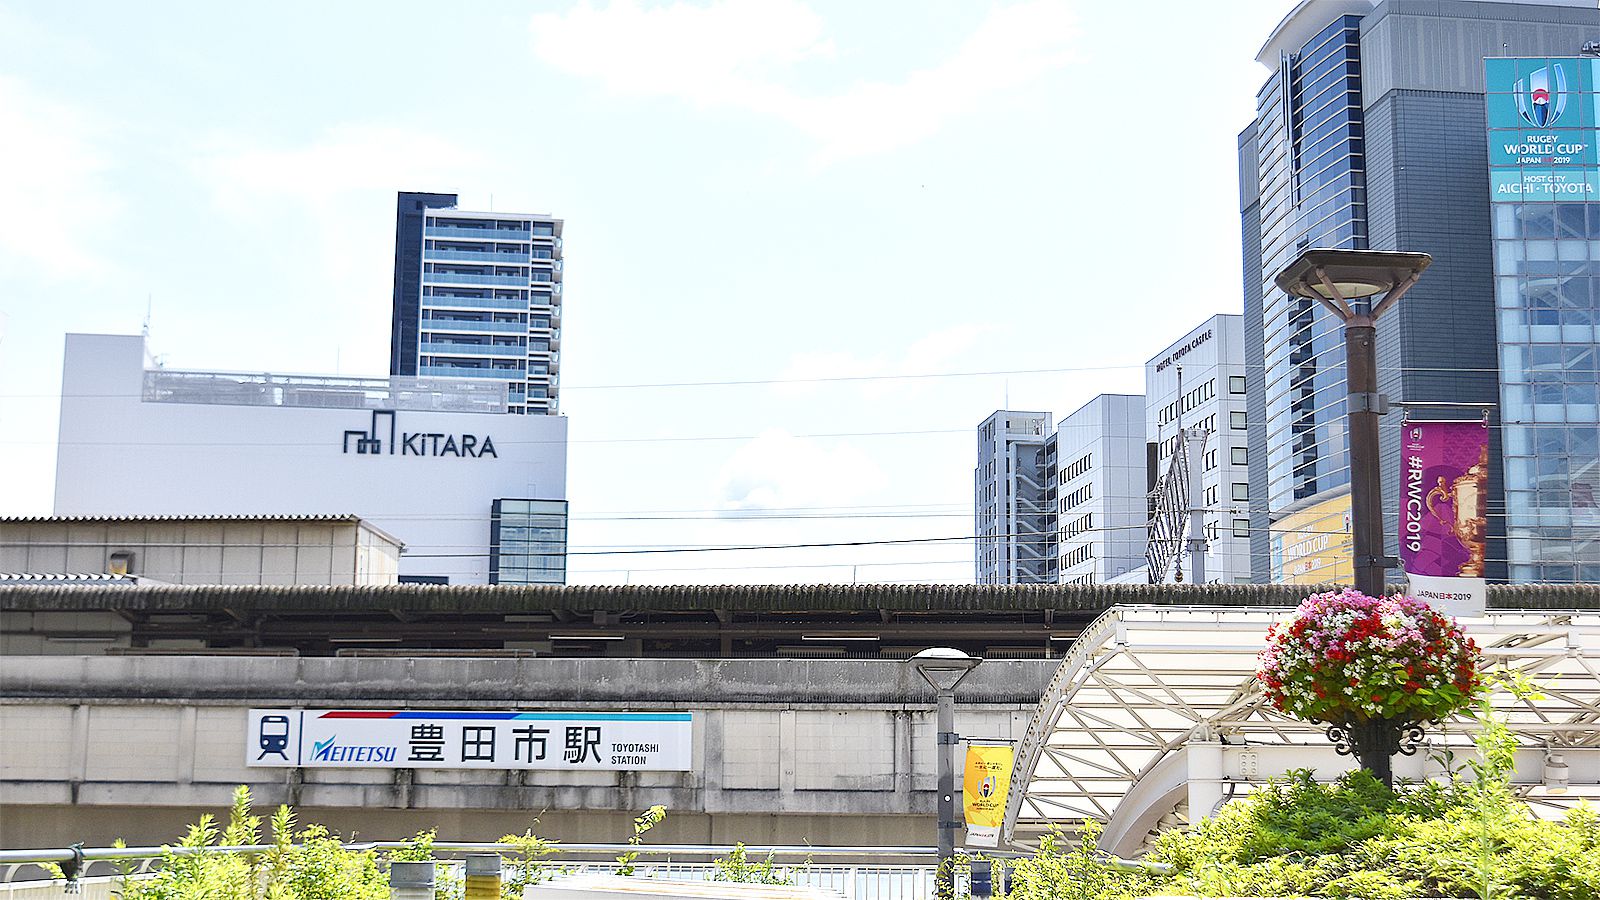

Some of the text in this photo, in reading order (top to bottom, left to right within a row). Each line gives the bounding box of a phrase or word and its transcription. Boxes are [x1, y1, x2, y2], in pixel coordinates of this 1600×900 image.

[1504, 144, 1554, 155] WORLD
[1191, 329, 1212, 349] CASTLE
[1407, 456, 1423, 552] #RWC2019
[1313, 534, 1329, 553] CUP
[310, 734, 398, 762] MEITETSU
[408, 724, 602, 763] 豊田市駅
[611, 743, 659, 753] TOYOTASHI
[611, 755, 647, 765] STATION
